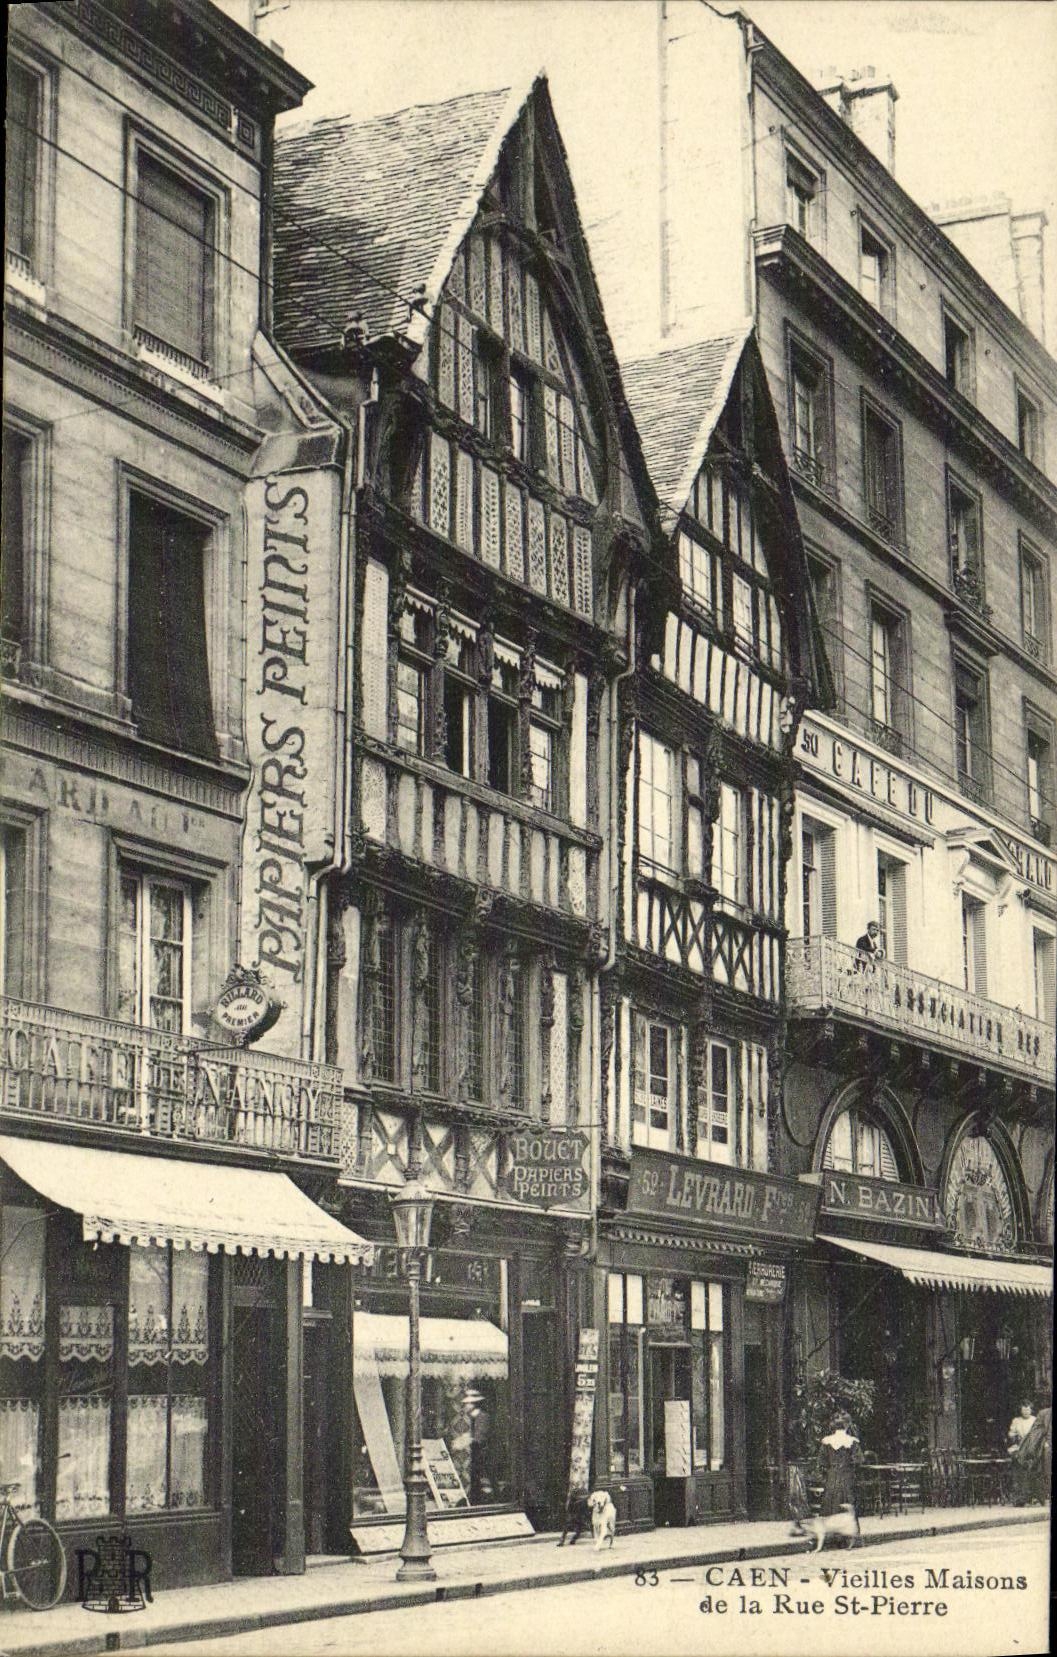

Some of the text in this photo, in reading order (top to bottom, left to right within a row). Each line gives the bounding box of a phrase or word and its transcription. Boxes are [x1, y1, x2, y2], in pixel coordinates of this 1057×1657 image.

[253, 480, 311, 984] PAPIERS PEINTS
[801, 728, 819, 758] 50
[908, 782, 935, 826] DU
[221, 986, 264, 1008] BILLARD
[222, 1011, 259, 1027] PREMIER
[513, 1137, 585, 1161] BOUET
[513, 1165, 583, 1192] PAPIERS
[518, 1182, 582, 1200] PEINTS
[665, 1164, 755, 1219] LEVRARD
[830, 1180, 930, 1218] N. BAZIN
